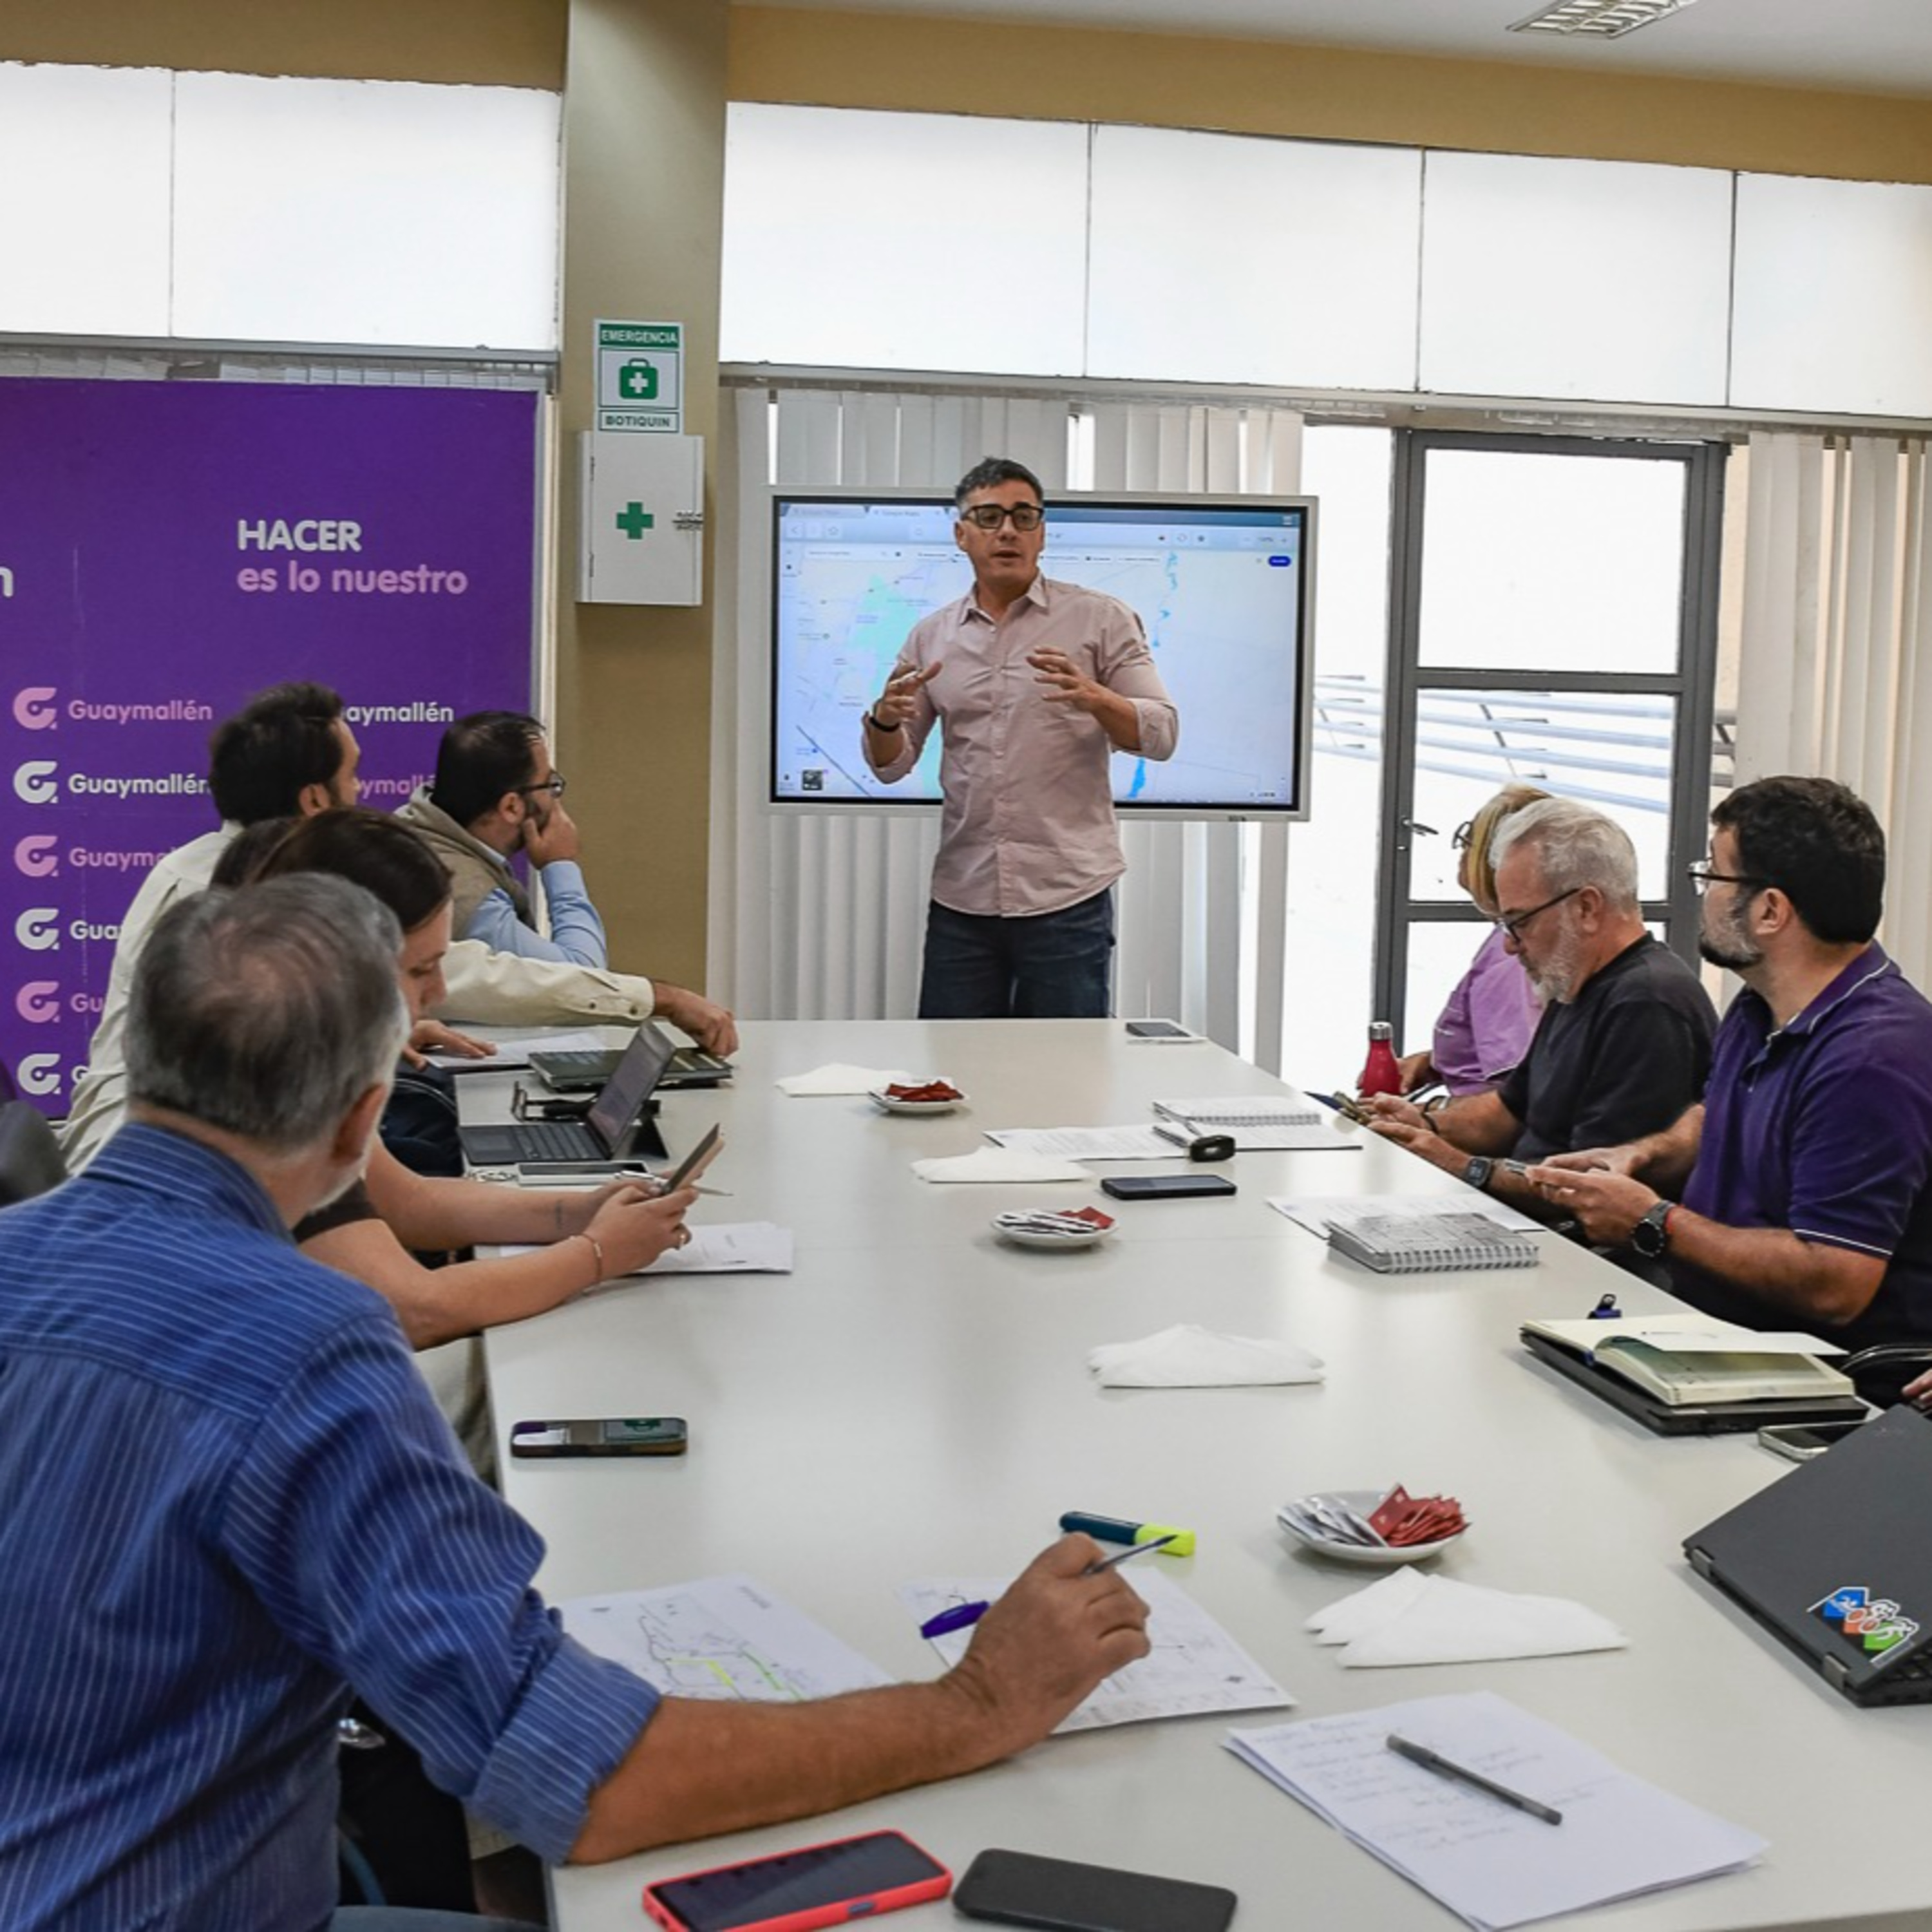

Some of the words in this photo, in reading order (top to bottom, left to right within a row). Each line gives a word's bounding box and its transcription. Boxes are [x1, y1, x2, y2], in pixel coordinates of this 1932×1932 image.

[601, 329, 678, 343] EMERGENCIA
[605, 415, 670, 427] BOTIQUIN
[238, 519, 362, 552] HACER
[237, 568, 278, 592] es
[289, 560, 321, 592] lo
[332, 564, 468, 594] nuestro
[68, 700, 213, 725] Guaymallén
[341, 701, 454, 726] aymallén
[69, 848, 166, 872] Guaym
